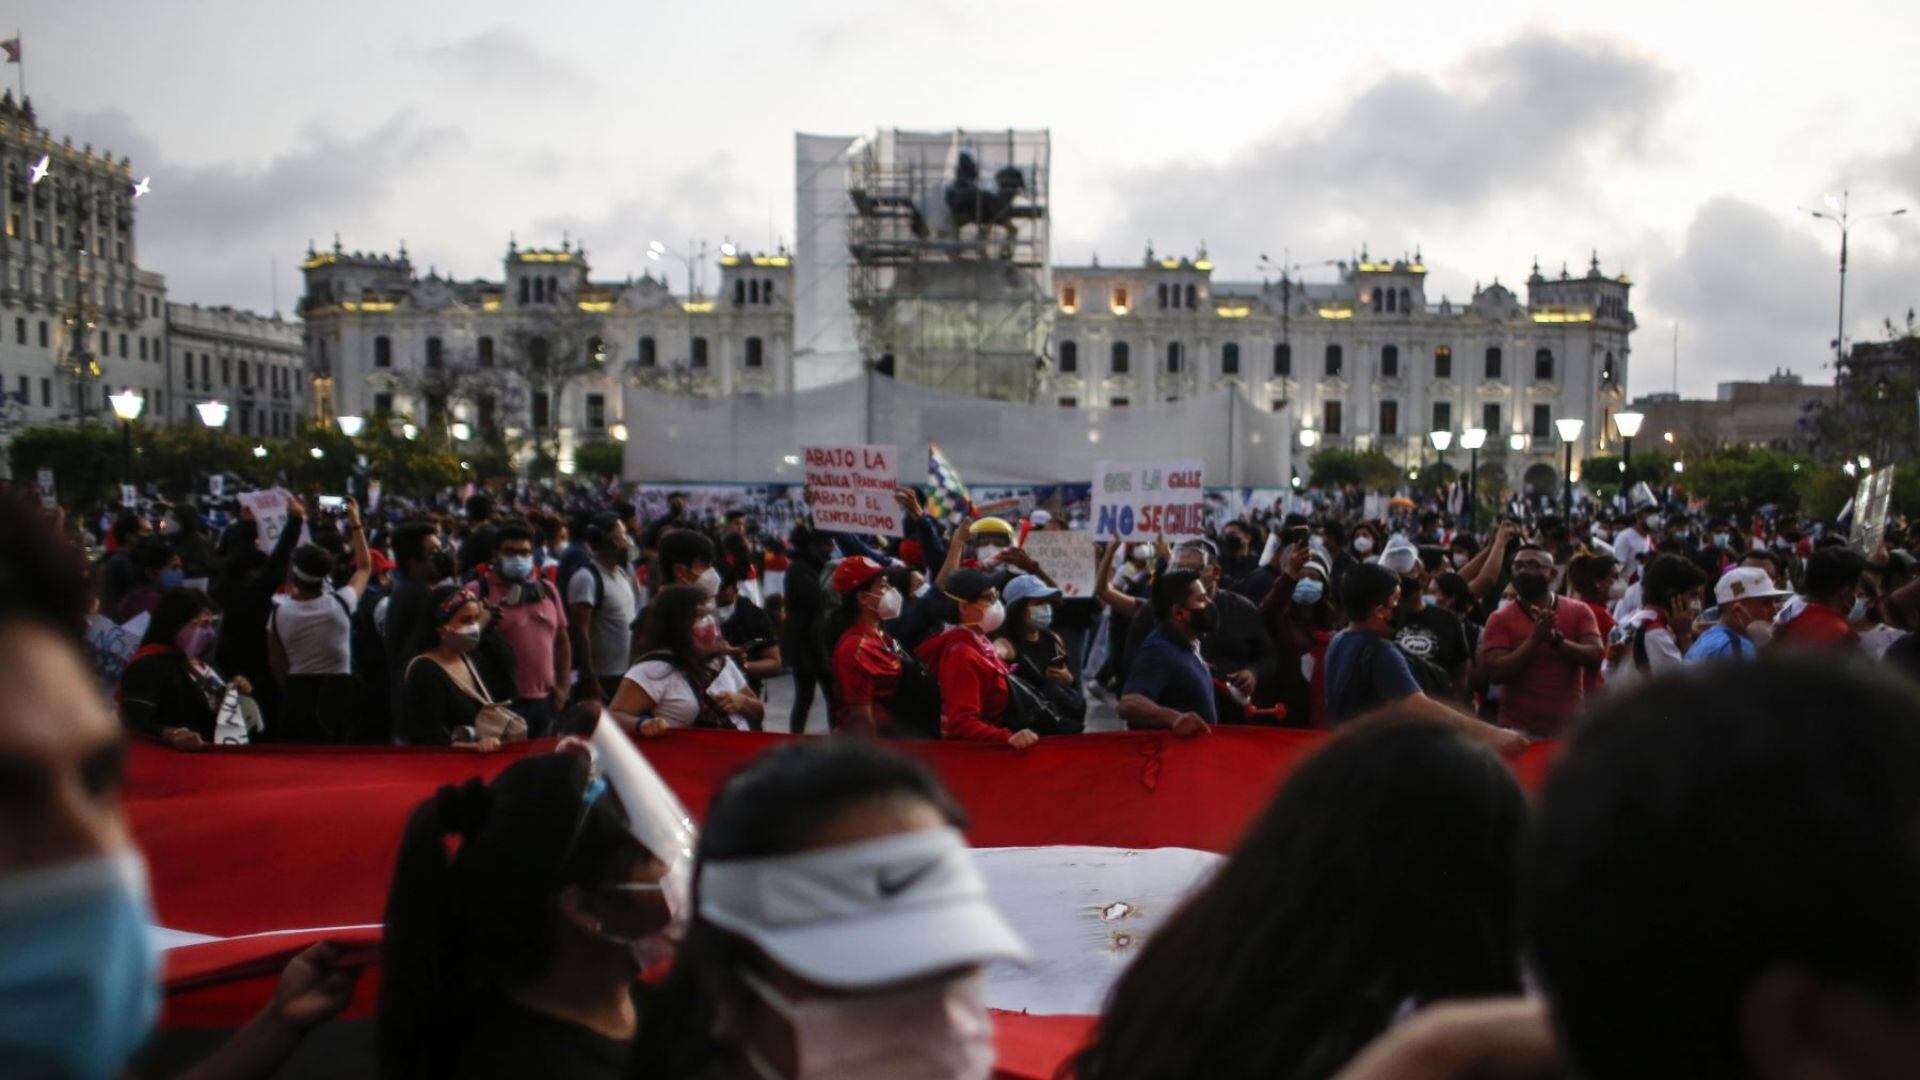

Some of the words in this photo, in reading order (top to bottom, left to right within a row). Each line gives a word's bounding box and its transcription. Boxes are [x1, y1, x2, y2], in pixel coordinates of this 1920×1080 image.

[806, 448, 855, 467] ABAJO
[863, 449, 885, 470] LA
[1141, 469, 1162, 491] LA
[813, 489, 856, 507] ABAJO
[865, 495, 882, 510] EL
[815, 509, 895, 530] CENTRALISMO
[1096, 504, 1134, 536] NO
[1137, 504, 1163, 533] SE
